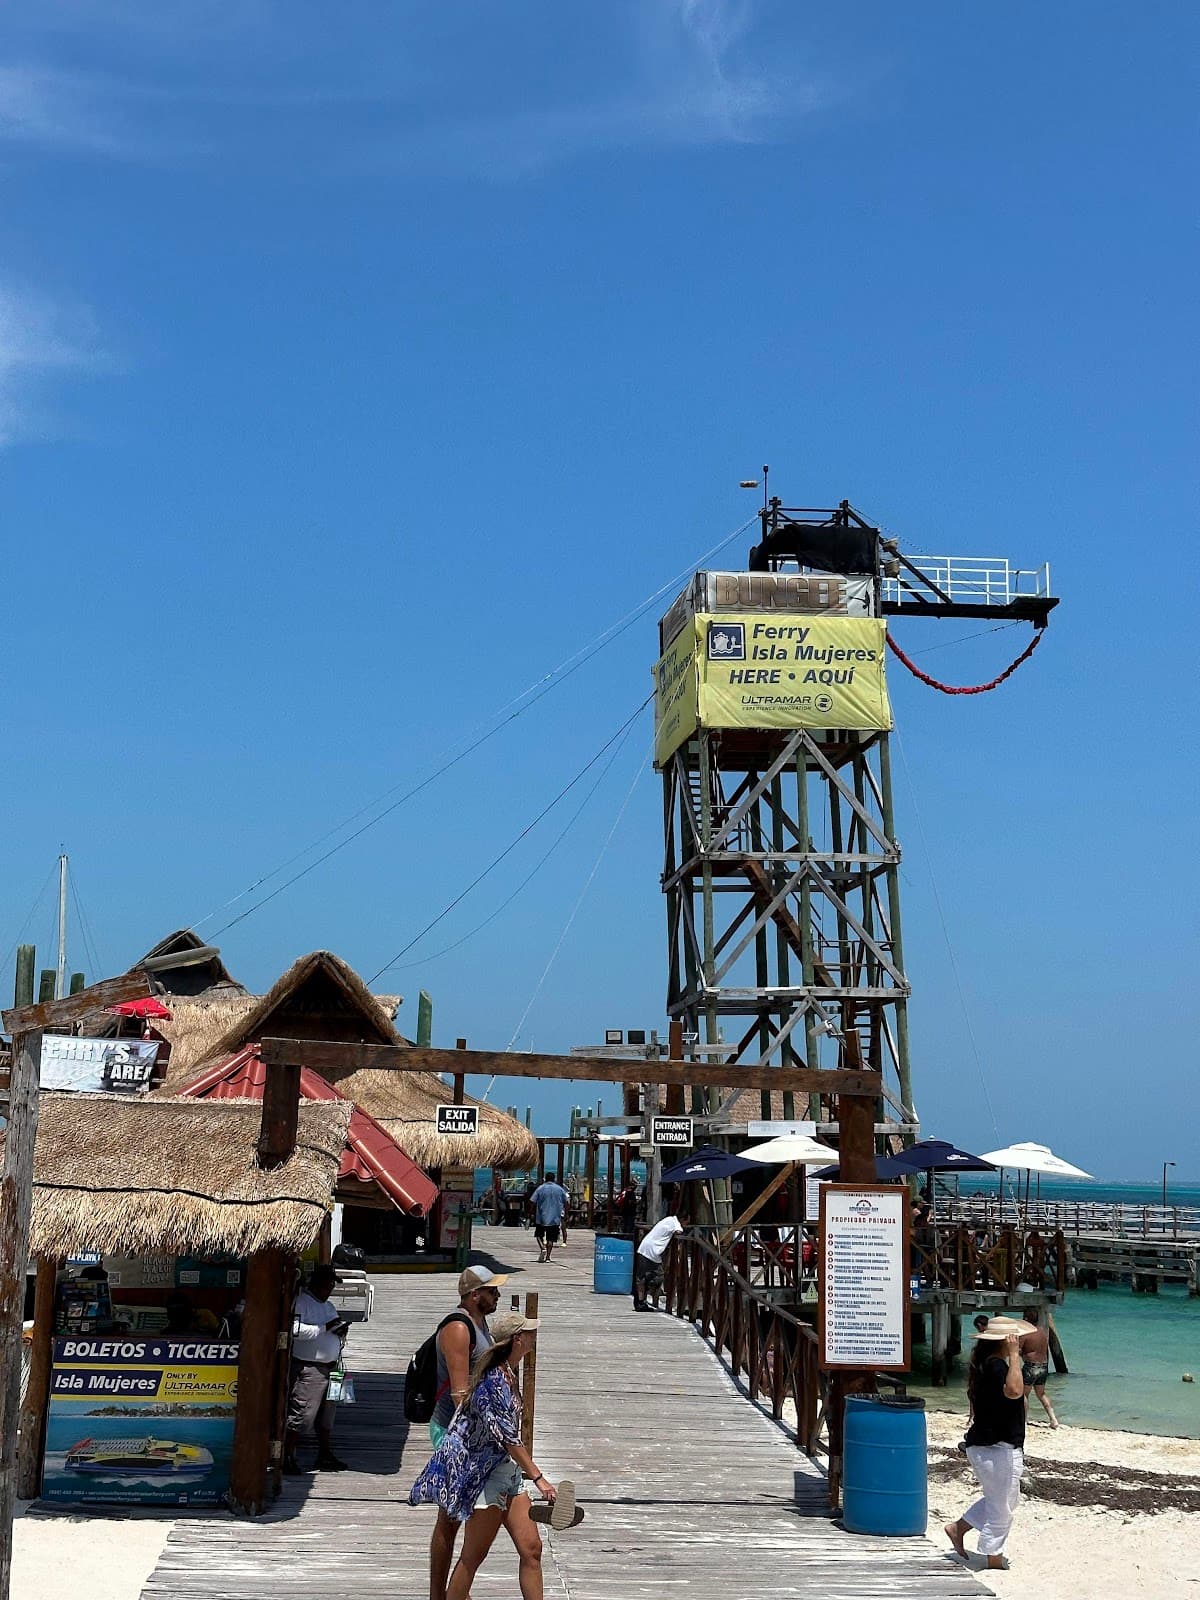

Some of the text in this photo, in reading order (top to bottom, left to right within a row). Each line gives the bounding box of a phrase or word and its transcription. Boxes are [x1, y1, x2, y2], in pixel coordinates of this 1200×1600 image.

[715, 575, 847, 609] BUNGEE
[752, 623, 810, 642] Ferry
[752, 645, 877, 665] Isla Mujeres
[729, 666, 855, 686] HERE AQUÍ
[741, 695, 811, 705] ULTRAMAR
[445, 1110, 470, 1120] EXIT
[439, 1121, 475, 1132] SALIDA
[655, 1121, 690, 1131] ENTRANCE
[656, 1132, 687, 1142] ENTRADA
[63, 1341, 239, 1360] BOLETOS TICKETS
[54, 1374, 226, 1393] Isla Mujeres ULTRAMAR
[166, 1372, 198, 1380] ONLY BY
